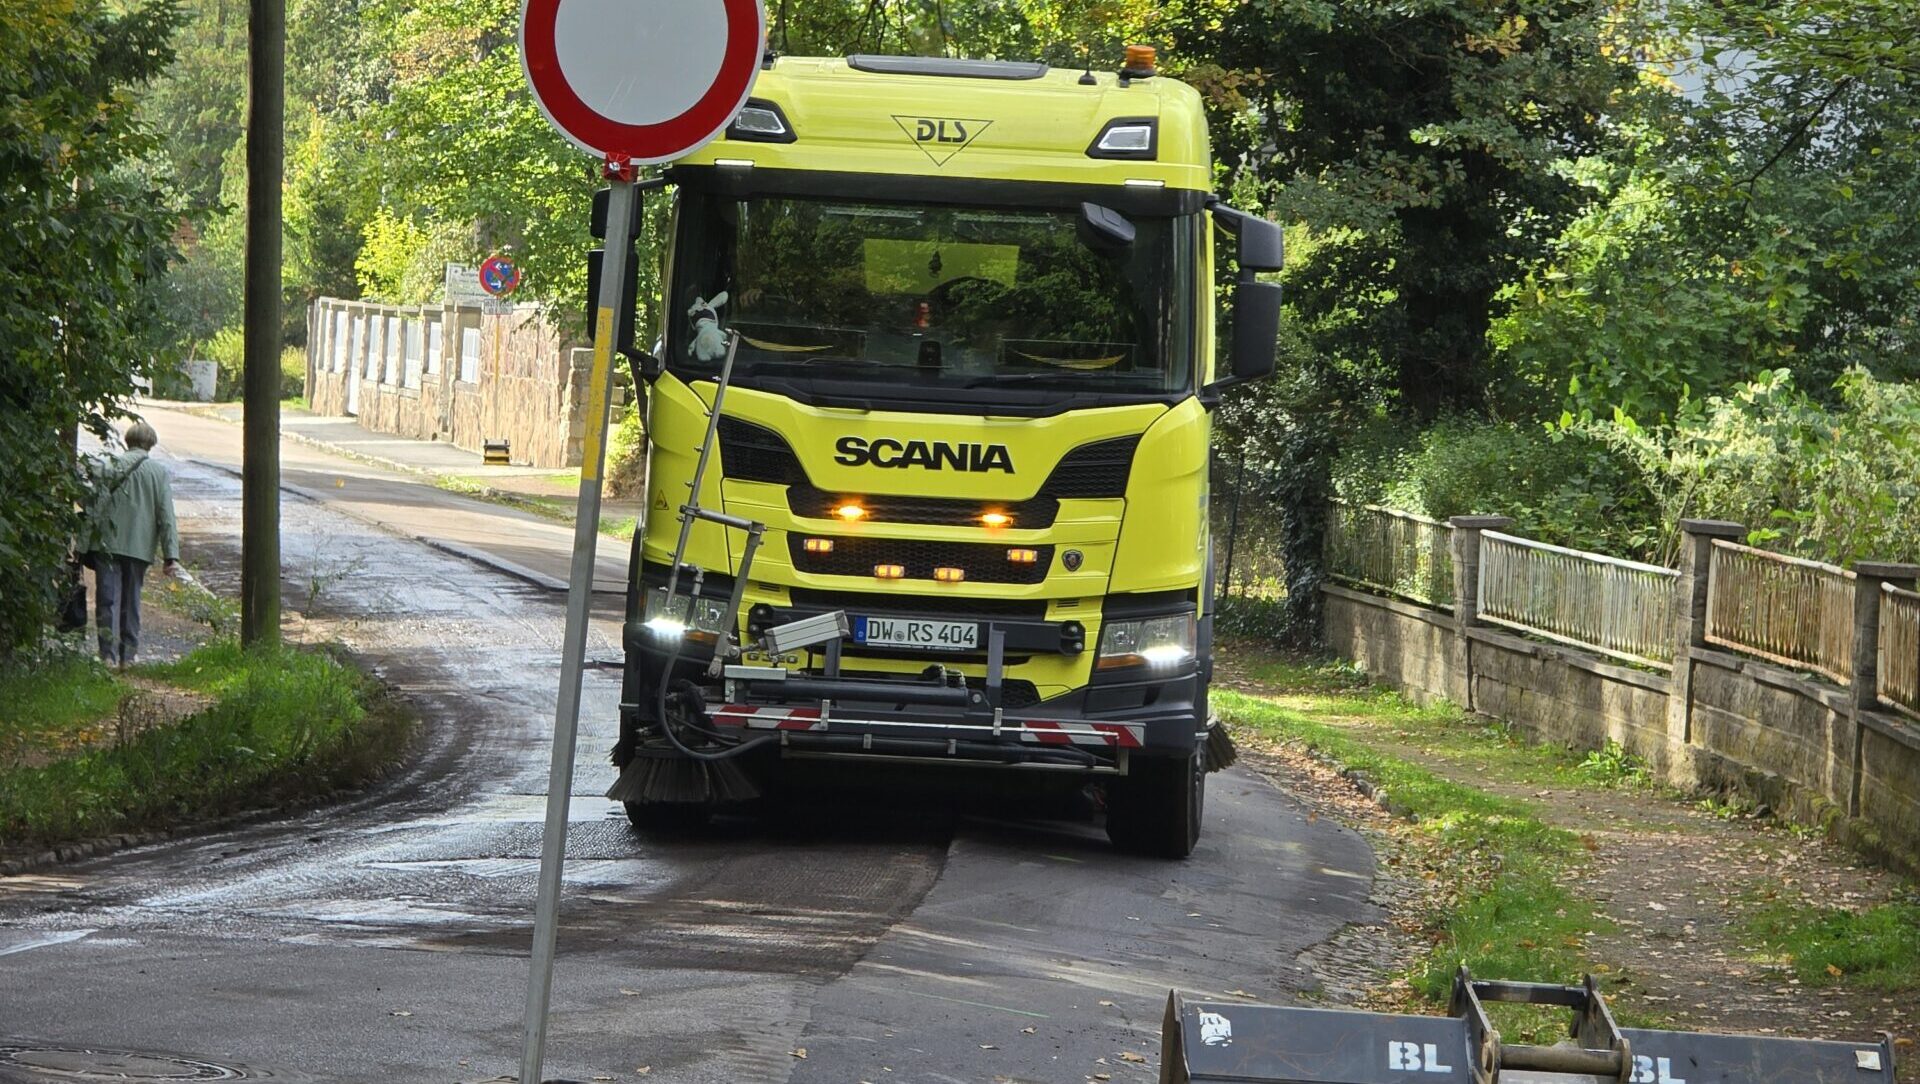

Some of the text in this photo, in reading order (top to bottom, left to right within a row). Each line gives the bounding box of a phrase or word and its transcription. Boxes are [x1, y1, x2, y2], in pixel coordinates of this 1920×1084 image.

[916, 119, 968, 143] DLS
[834, 436, 1015, 474] SCANIA
[867, 620, 975, 645] DW RS 404
[1388, 1040, 1452, 1073] BL
[1628, 1054, 1686, 1084] BL
